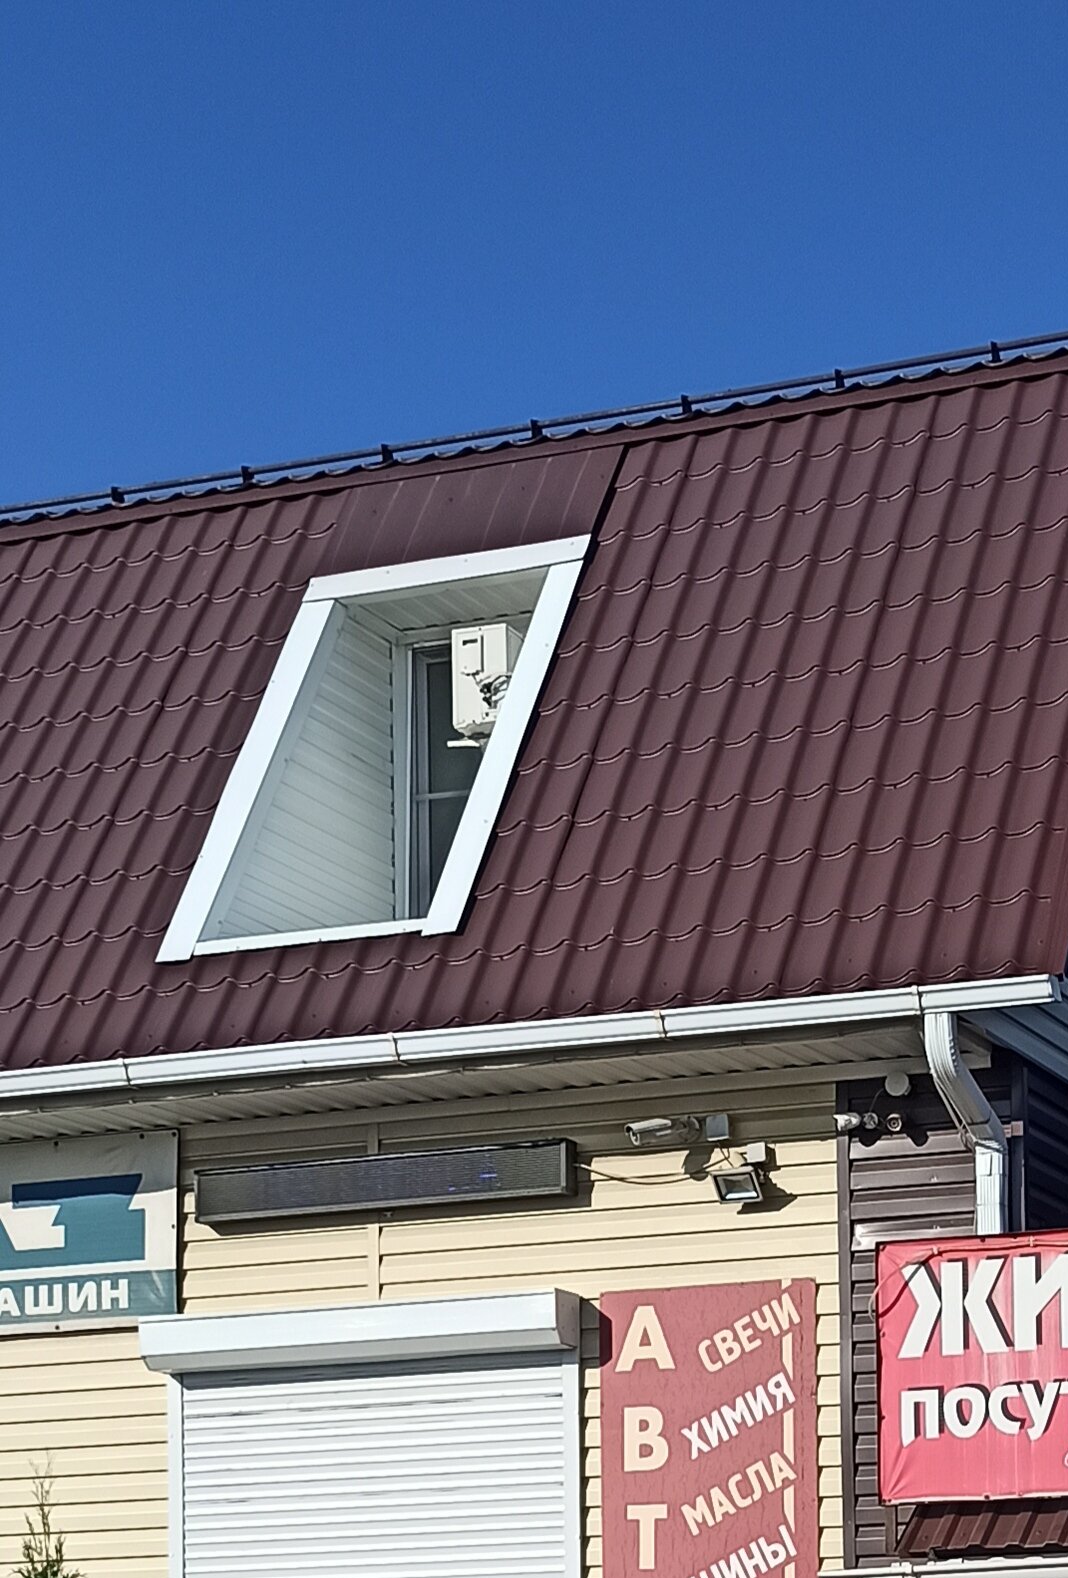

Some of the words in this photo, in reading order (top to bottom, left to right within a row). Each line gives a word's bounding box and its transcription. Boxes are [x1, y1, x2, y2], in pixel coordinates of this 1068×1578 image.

[0, 1279, 129, 1317] АШИН
[698, 1292, 800, 1373] СВЕЧИ
[681, 1371, 795, 1461] ХИМИЯ
[680, 1451, 798, 1537] МАСЛА
